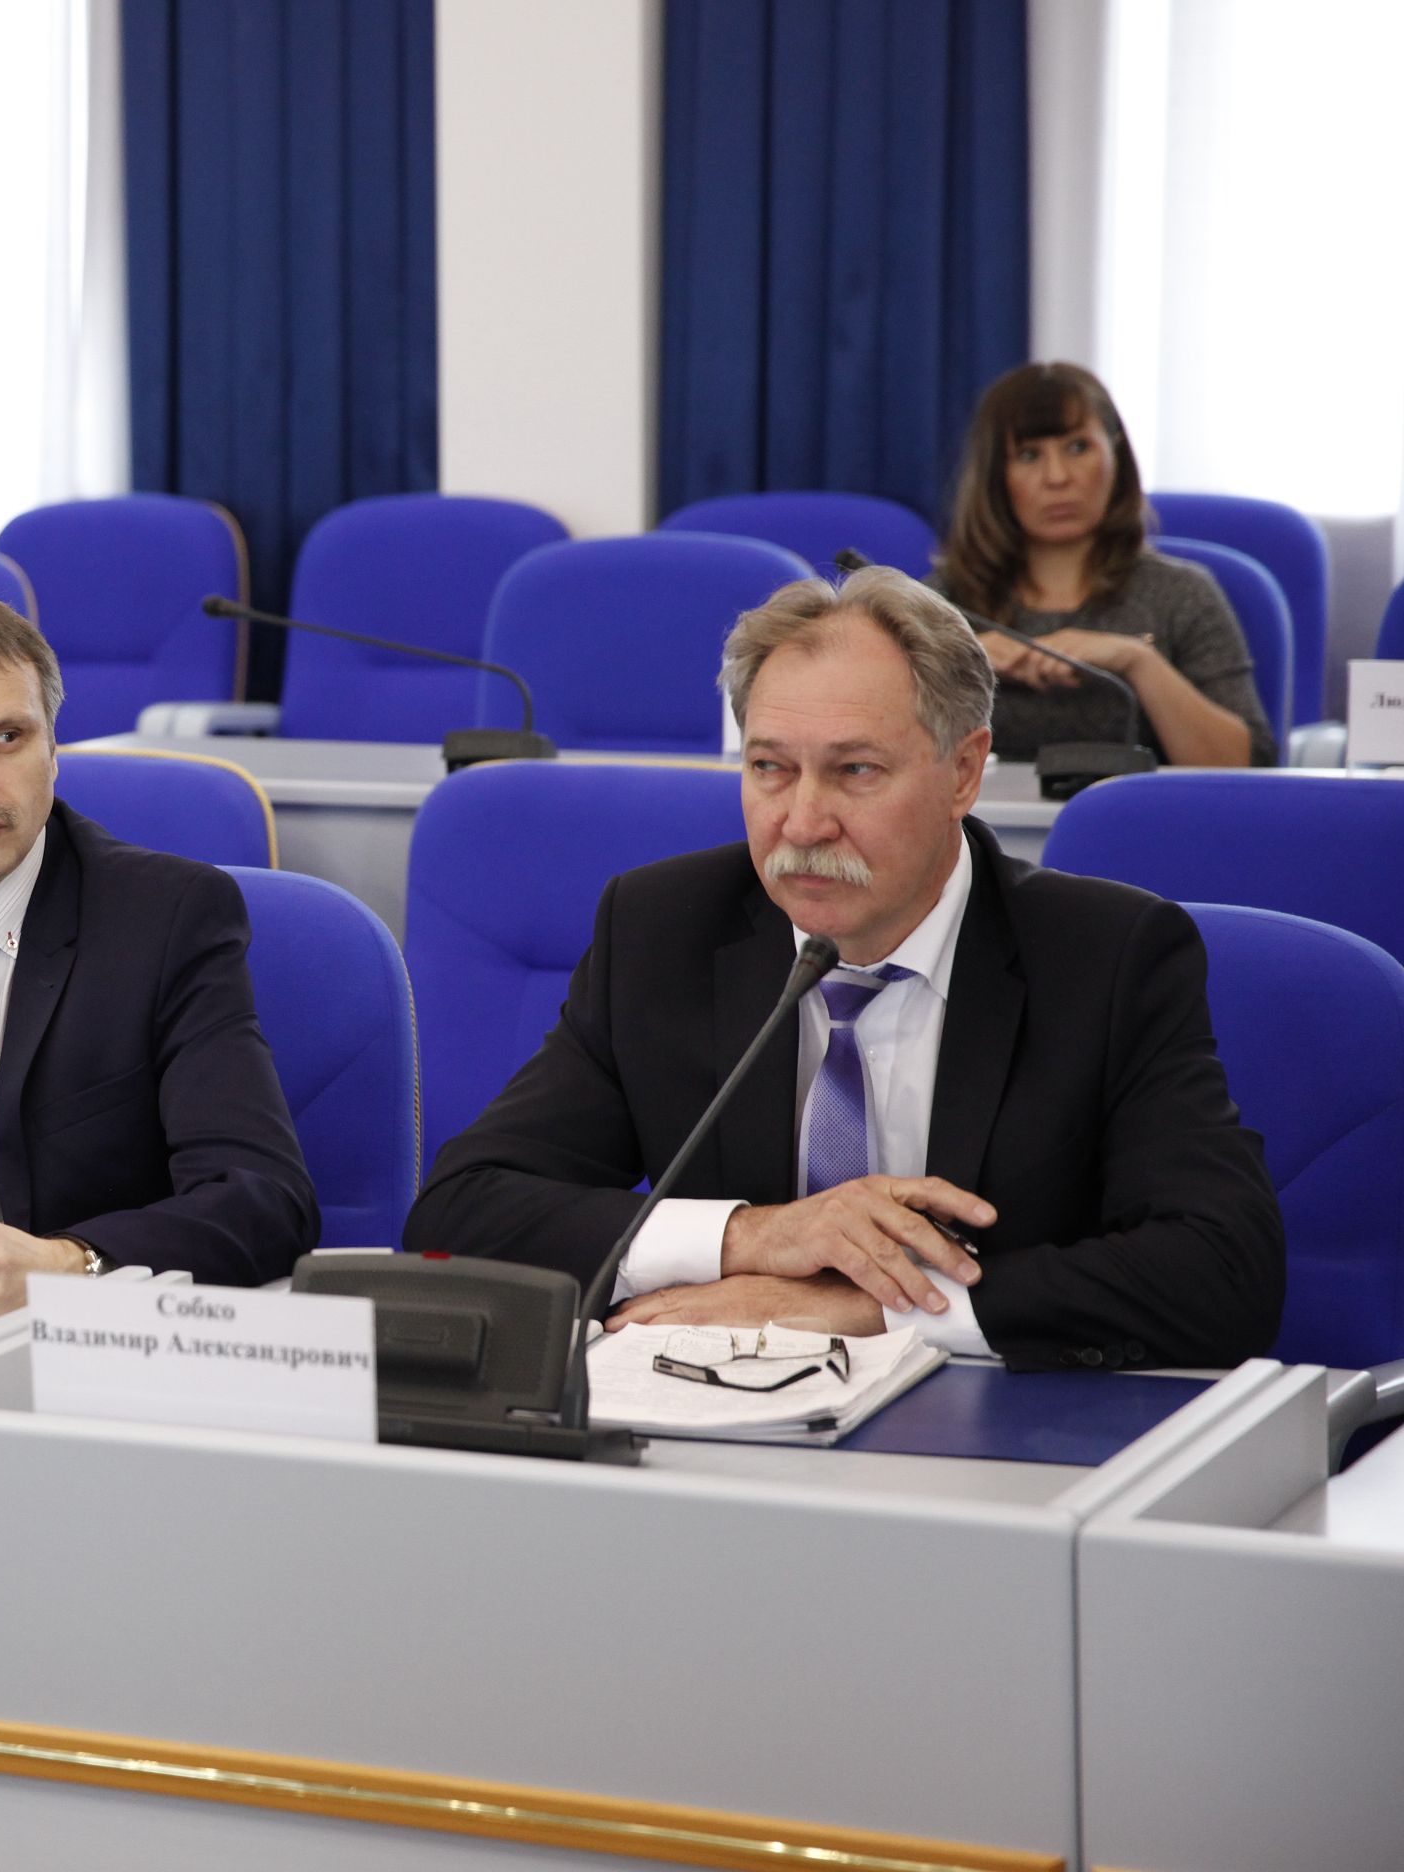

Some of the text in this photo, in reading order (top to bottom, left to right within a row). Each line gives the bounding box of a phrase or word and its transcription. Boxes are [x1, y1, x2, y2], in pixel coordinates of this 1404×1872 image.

[156, 1293, 237, 1321] Собко
[32, 1320, 369, 1370] Владимир Александрович
